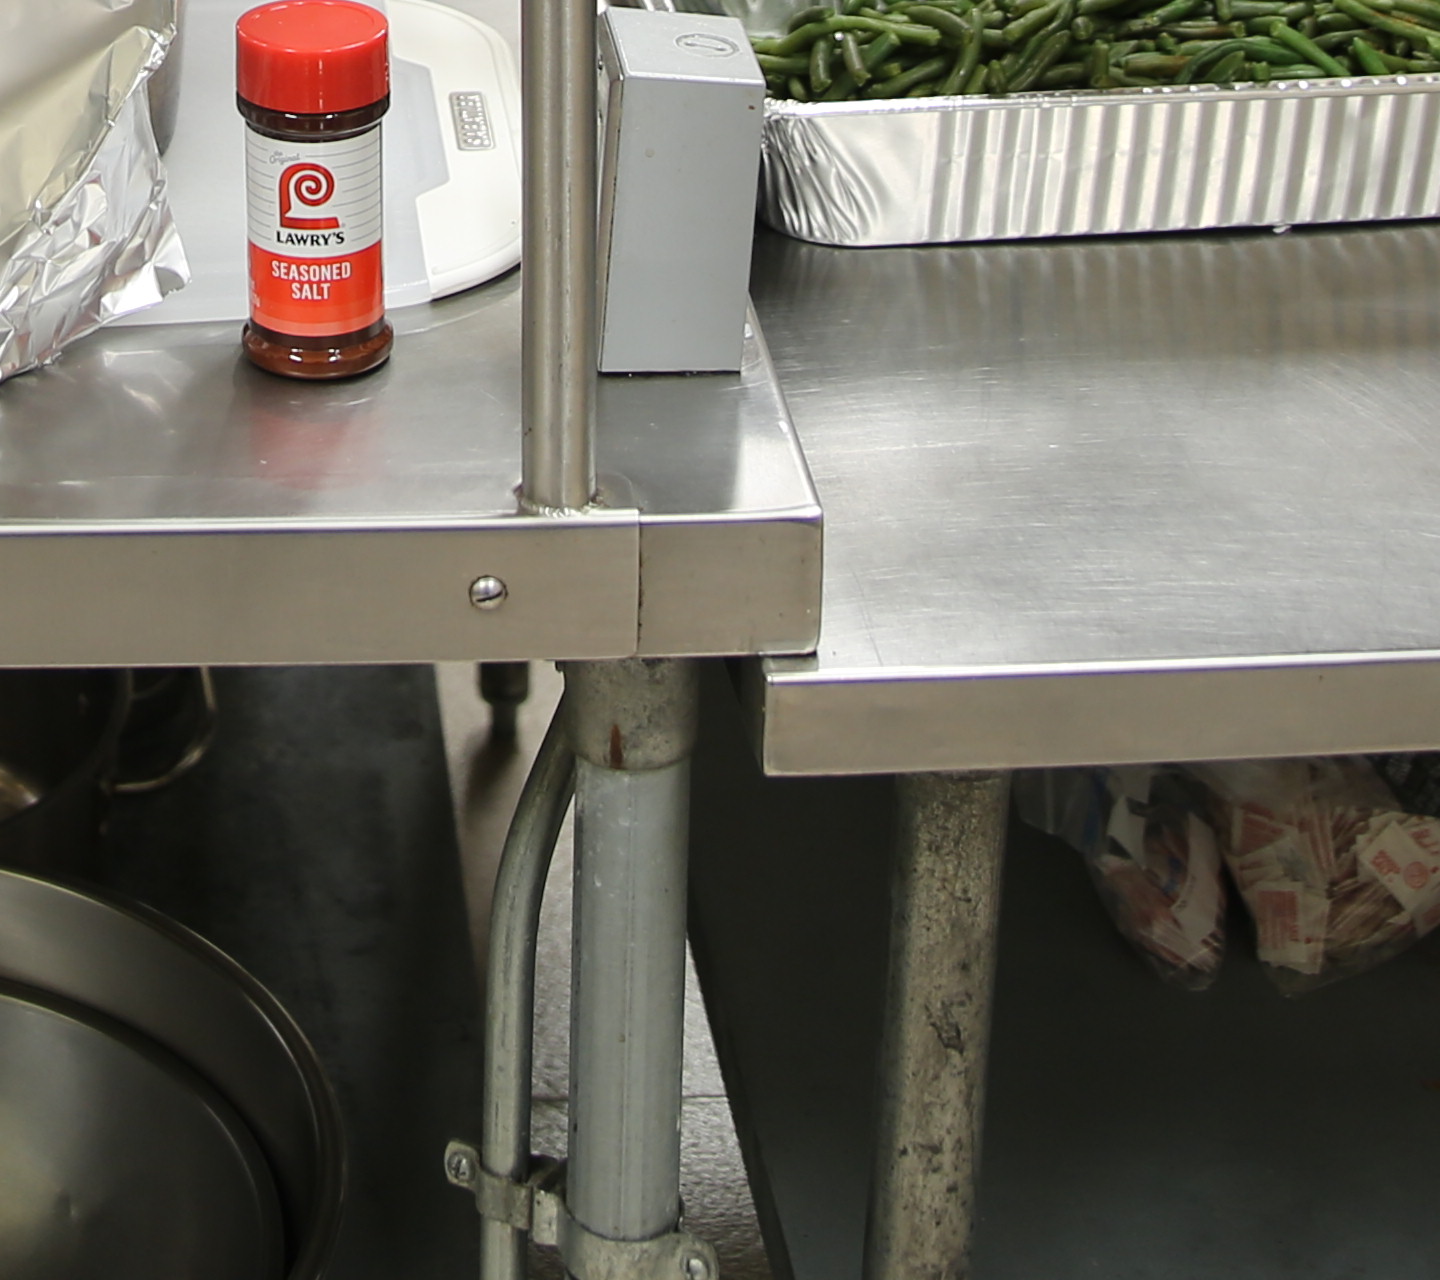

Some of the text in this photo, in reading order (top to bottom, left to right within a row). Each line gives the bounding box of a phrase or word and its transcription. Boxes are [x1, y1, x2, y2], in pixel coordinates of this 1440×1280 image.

[276, 230, 345, 246] LAWRY'S
[272, 260, 351, 281] SEASONED
[291, 282, 331, 300] SALT
